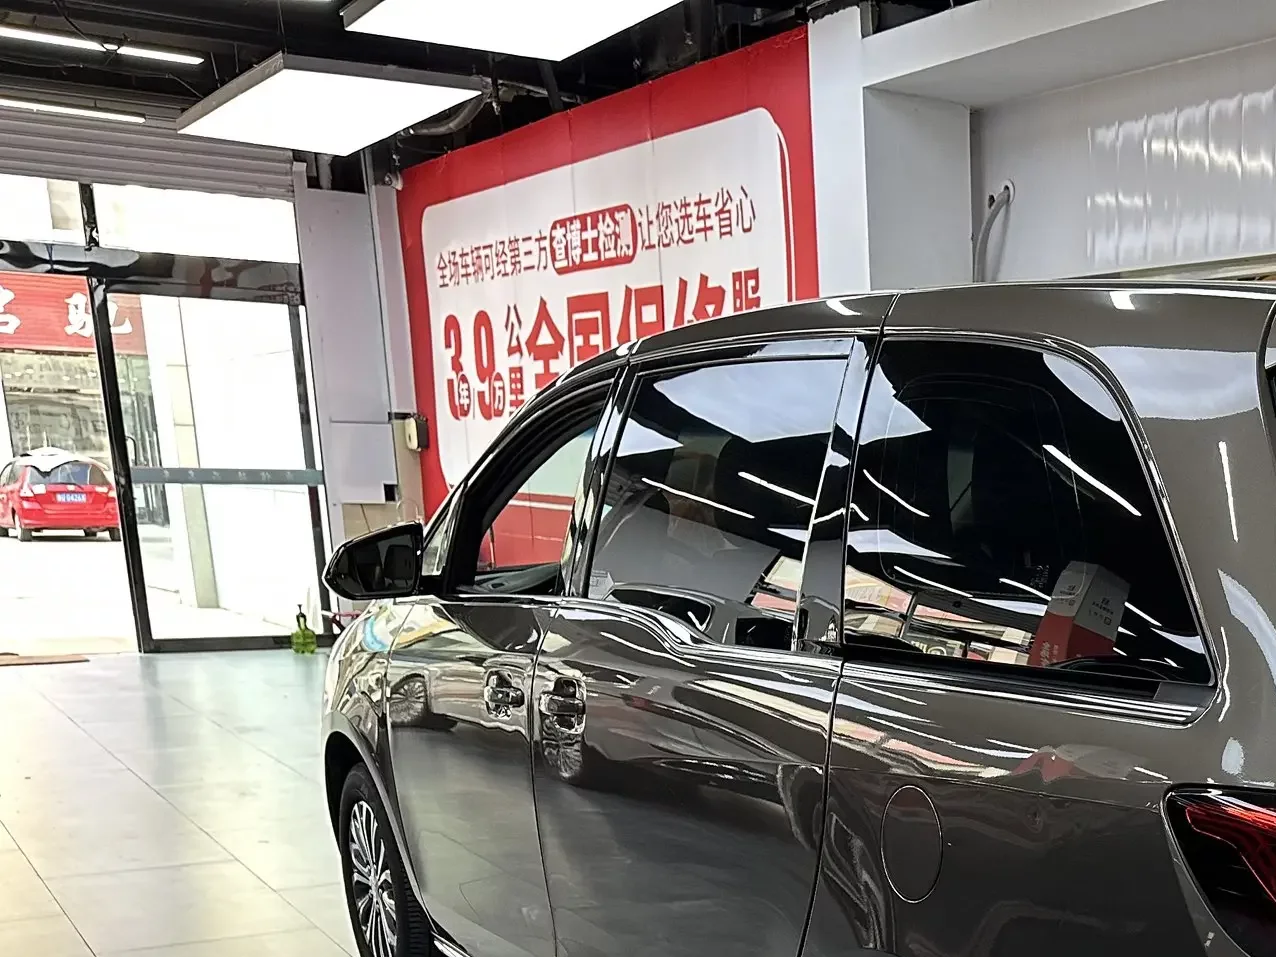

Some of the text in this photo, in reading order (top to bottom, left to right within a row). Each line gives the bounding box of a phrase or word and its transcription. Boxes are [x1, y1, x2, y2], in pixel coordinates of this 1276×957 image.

[437, 185, 757, 288] 全场车辆可经第三方 查博士检测 让您选车省心
